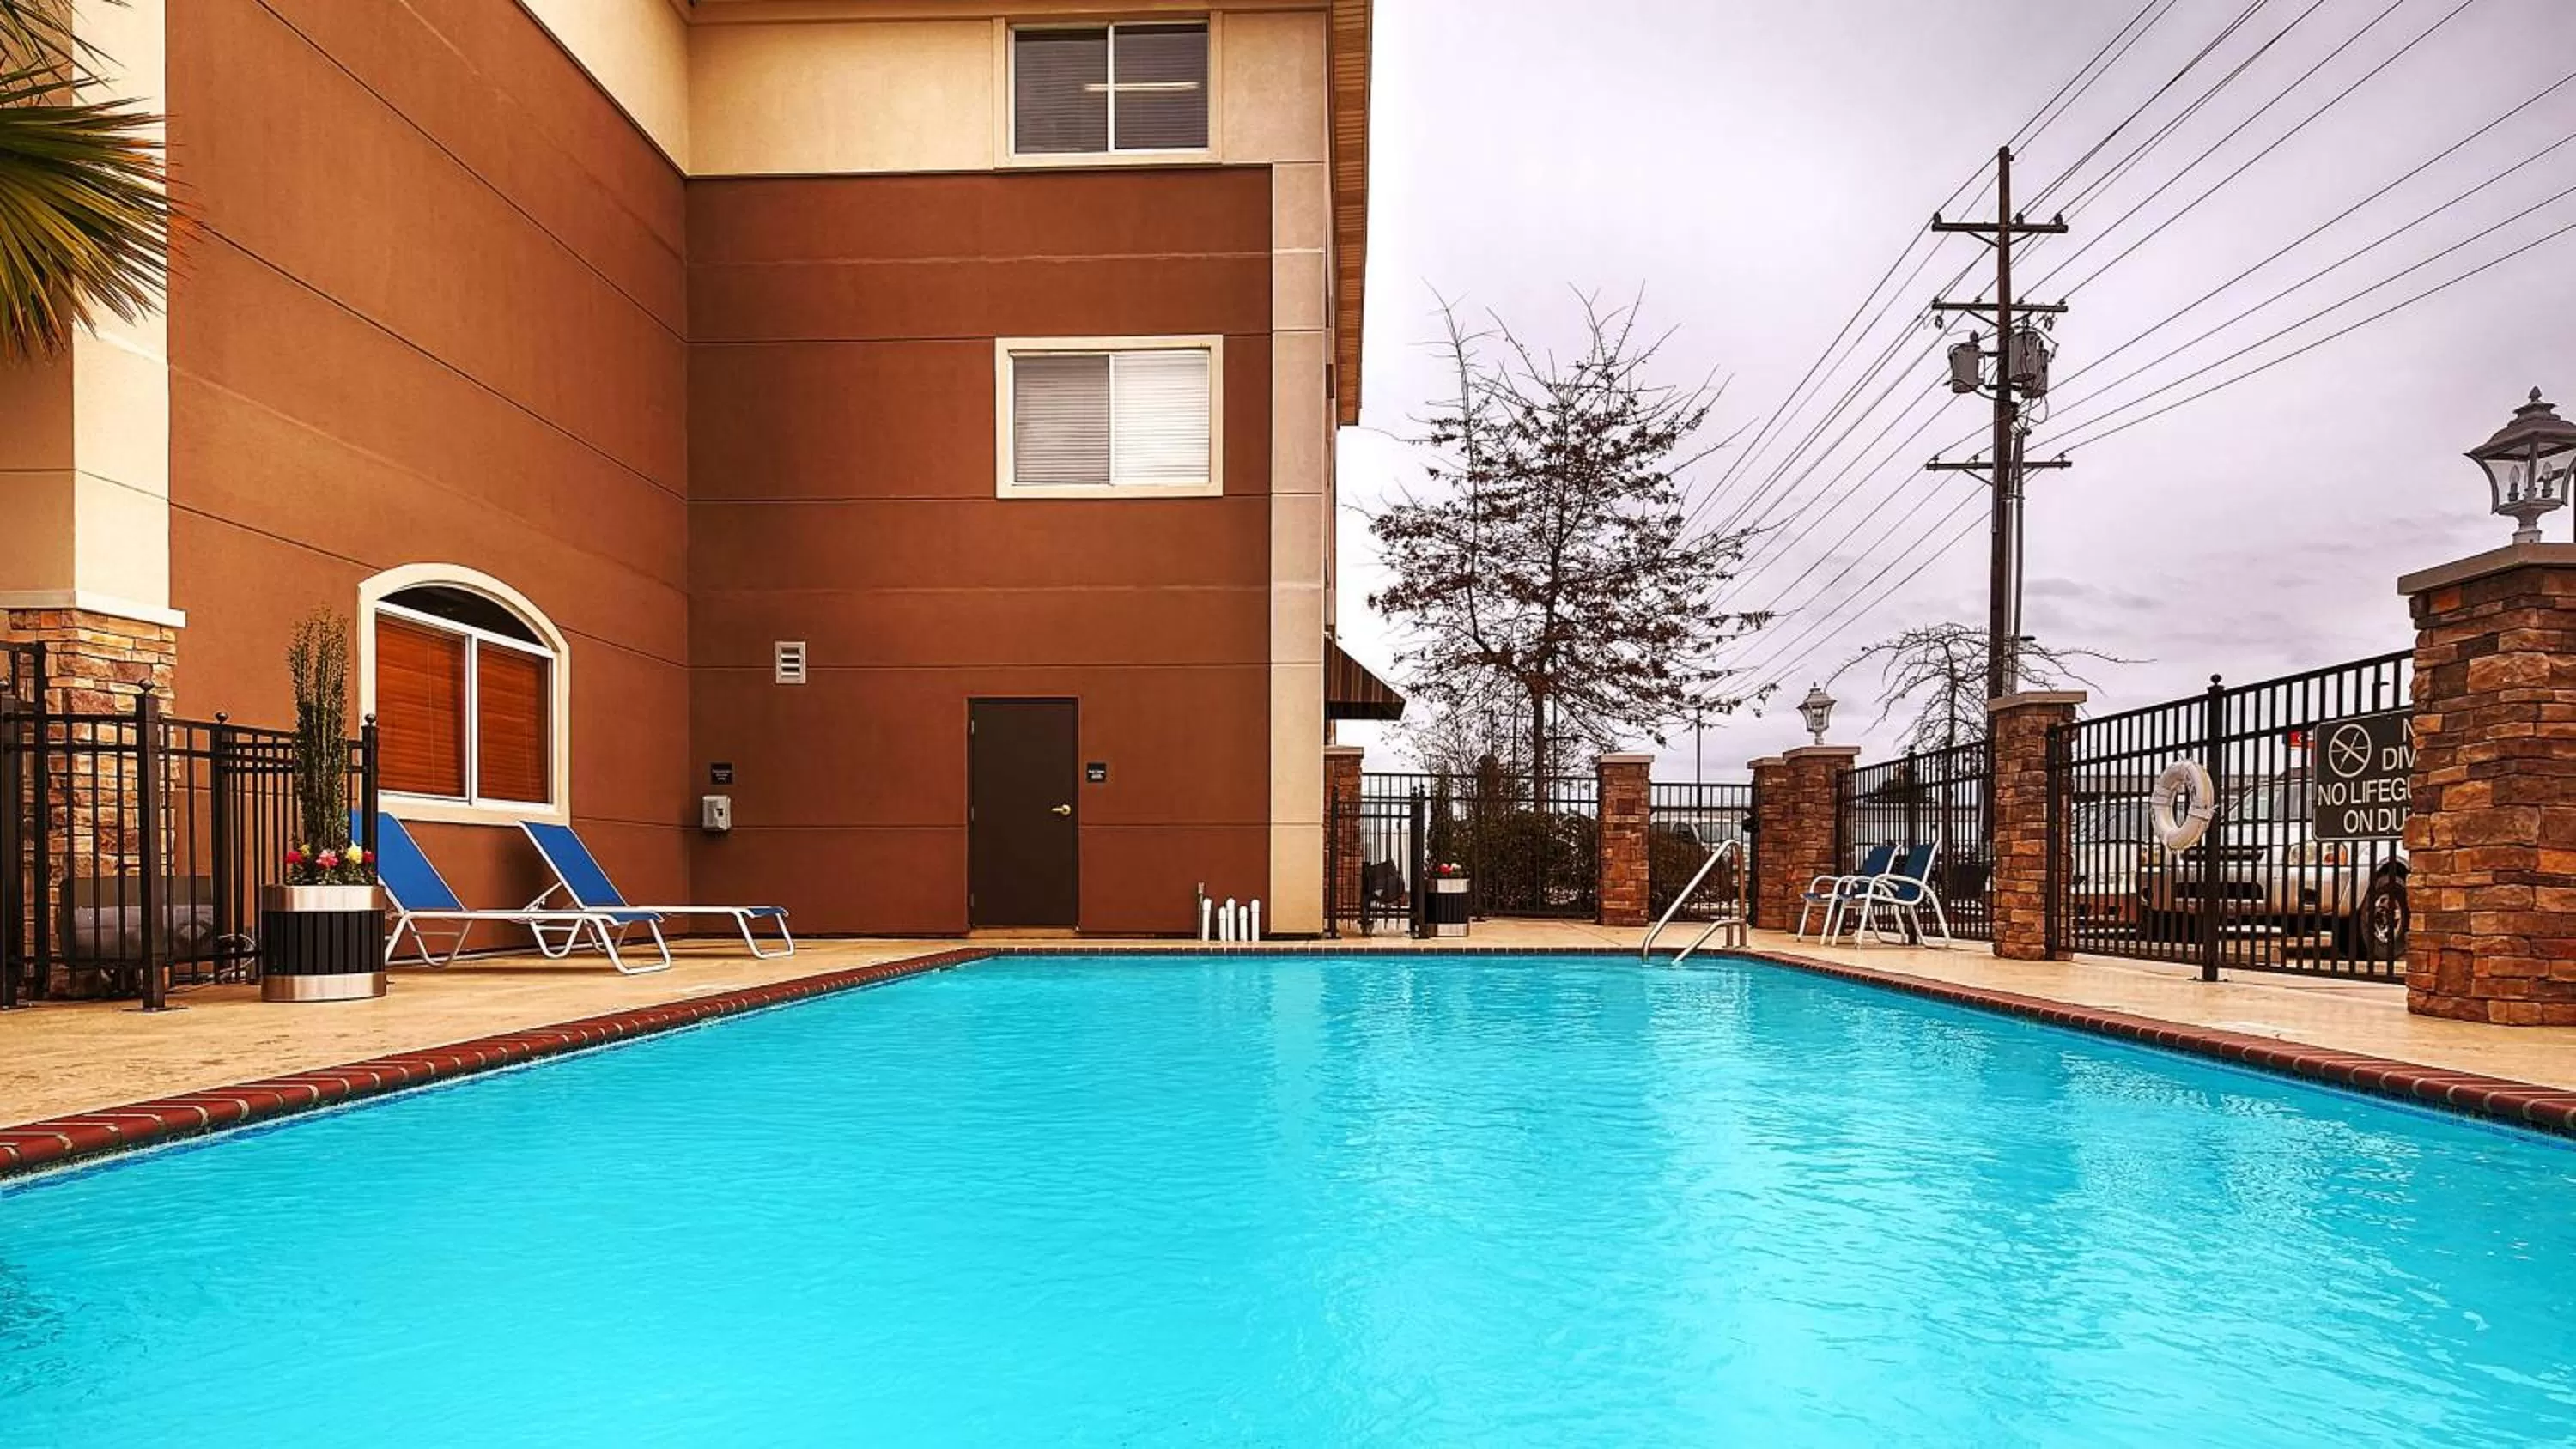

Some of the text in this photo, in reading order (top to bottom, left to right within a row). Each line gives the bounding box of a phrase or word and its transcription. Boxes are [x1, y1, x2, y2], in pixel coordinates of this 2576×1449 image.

[2403, 718, 2416, 742] N
[2383, 745, 2417, 771] DIV
[2318, 777, 2412, 806] NO LIFEG
[2343, 807, 2408, 833] ON DU
